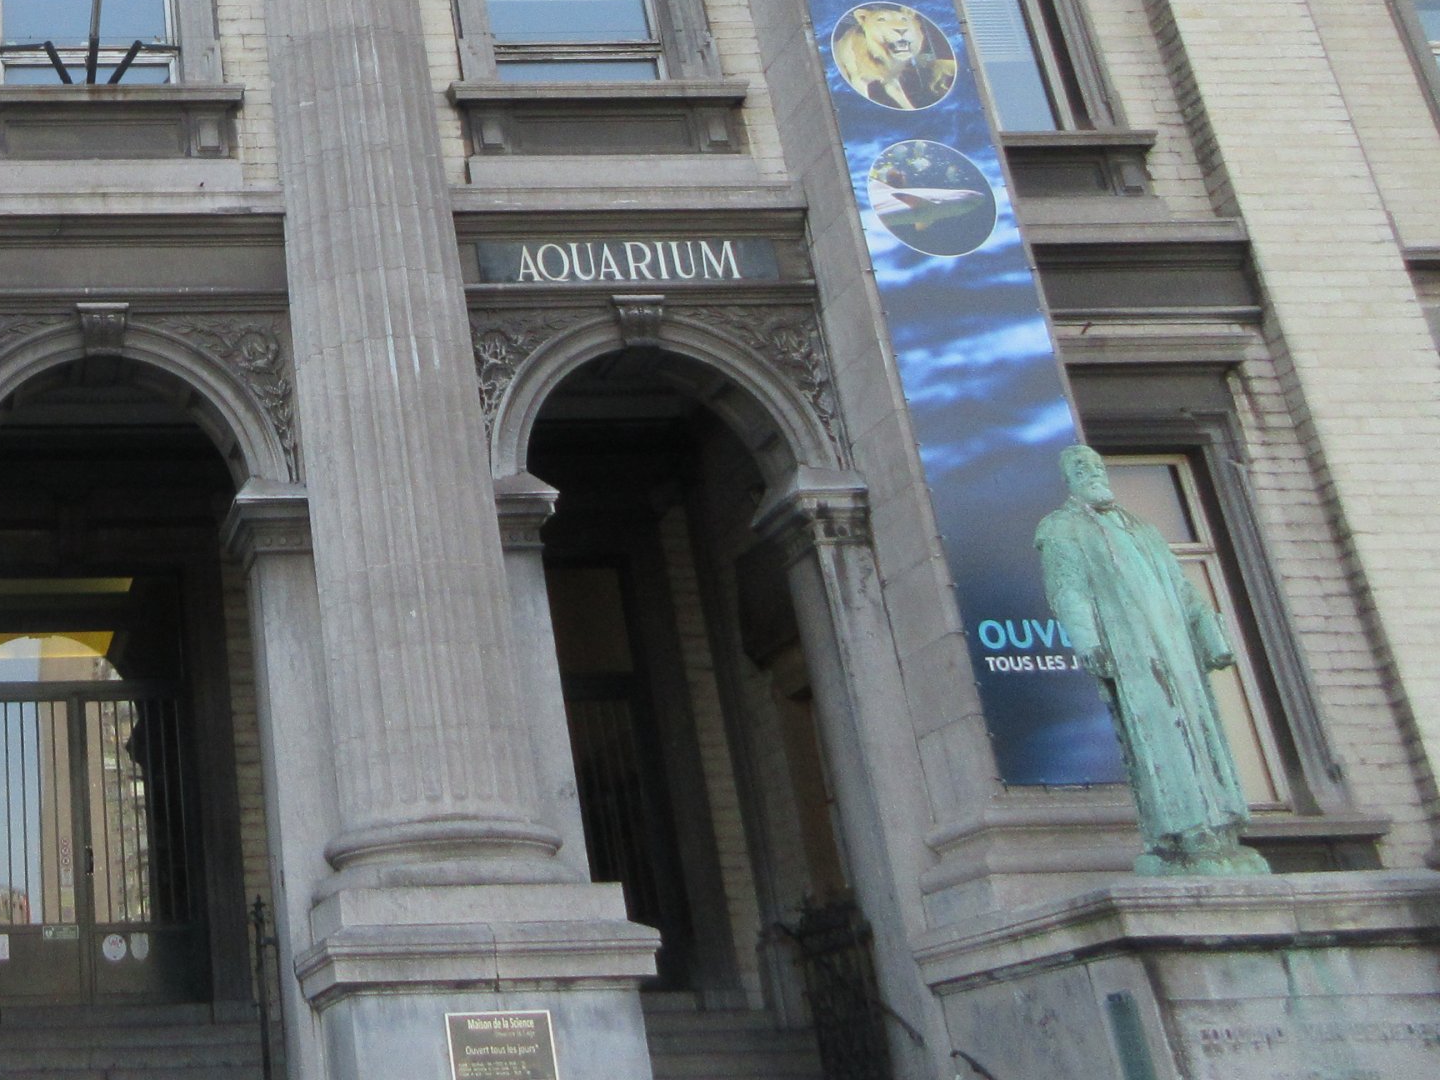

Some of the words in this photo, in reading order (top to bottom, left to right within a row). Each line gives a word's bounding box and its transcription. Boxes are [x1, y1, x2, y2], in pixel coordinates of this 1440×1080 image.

[517, 240, 742, 282] AQUARIUM
[985, 656, 1034, 671] TOUS
[1037, 655, 1066, 670] LES
[467, 1019, 492, 1030] Maison
[493, 1017, 501, 1029] de
[502, 1017, 509, 1029] la
[510, 1017, 535, 1028] Science
[465, 1045, 490, 1055] Ouvert
[490, 1046, 506, 1054] tous
[507, 1043, 518, 1054] les
